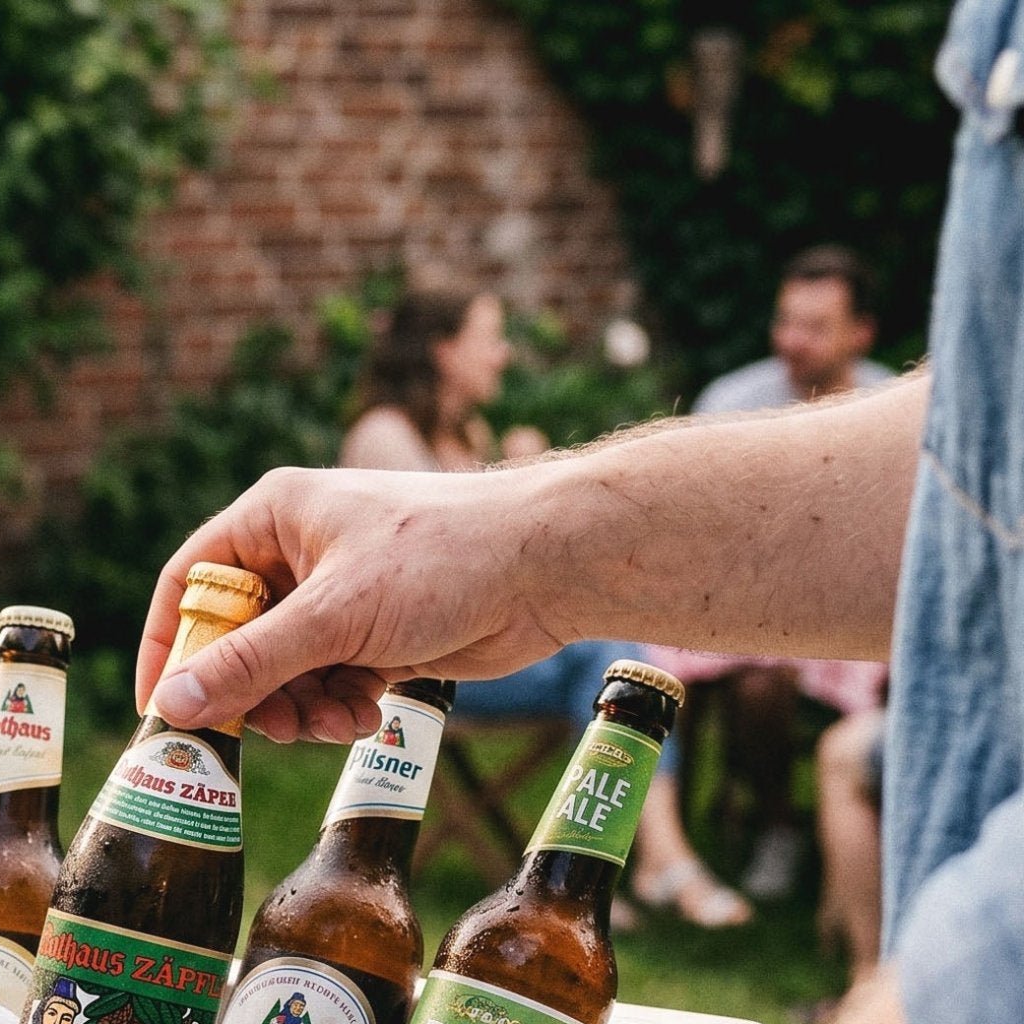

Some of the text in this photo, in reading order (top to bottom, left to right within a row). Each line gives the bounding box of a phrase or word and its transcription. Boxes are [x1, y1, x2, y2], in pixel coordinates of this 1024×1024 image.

[120, 761, 176, 794] othaus
[349, 746, 423, 780] Pilsner
[562, 764, 631, 808] PALE
[557, 794, 612, 832] ALE
